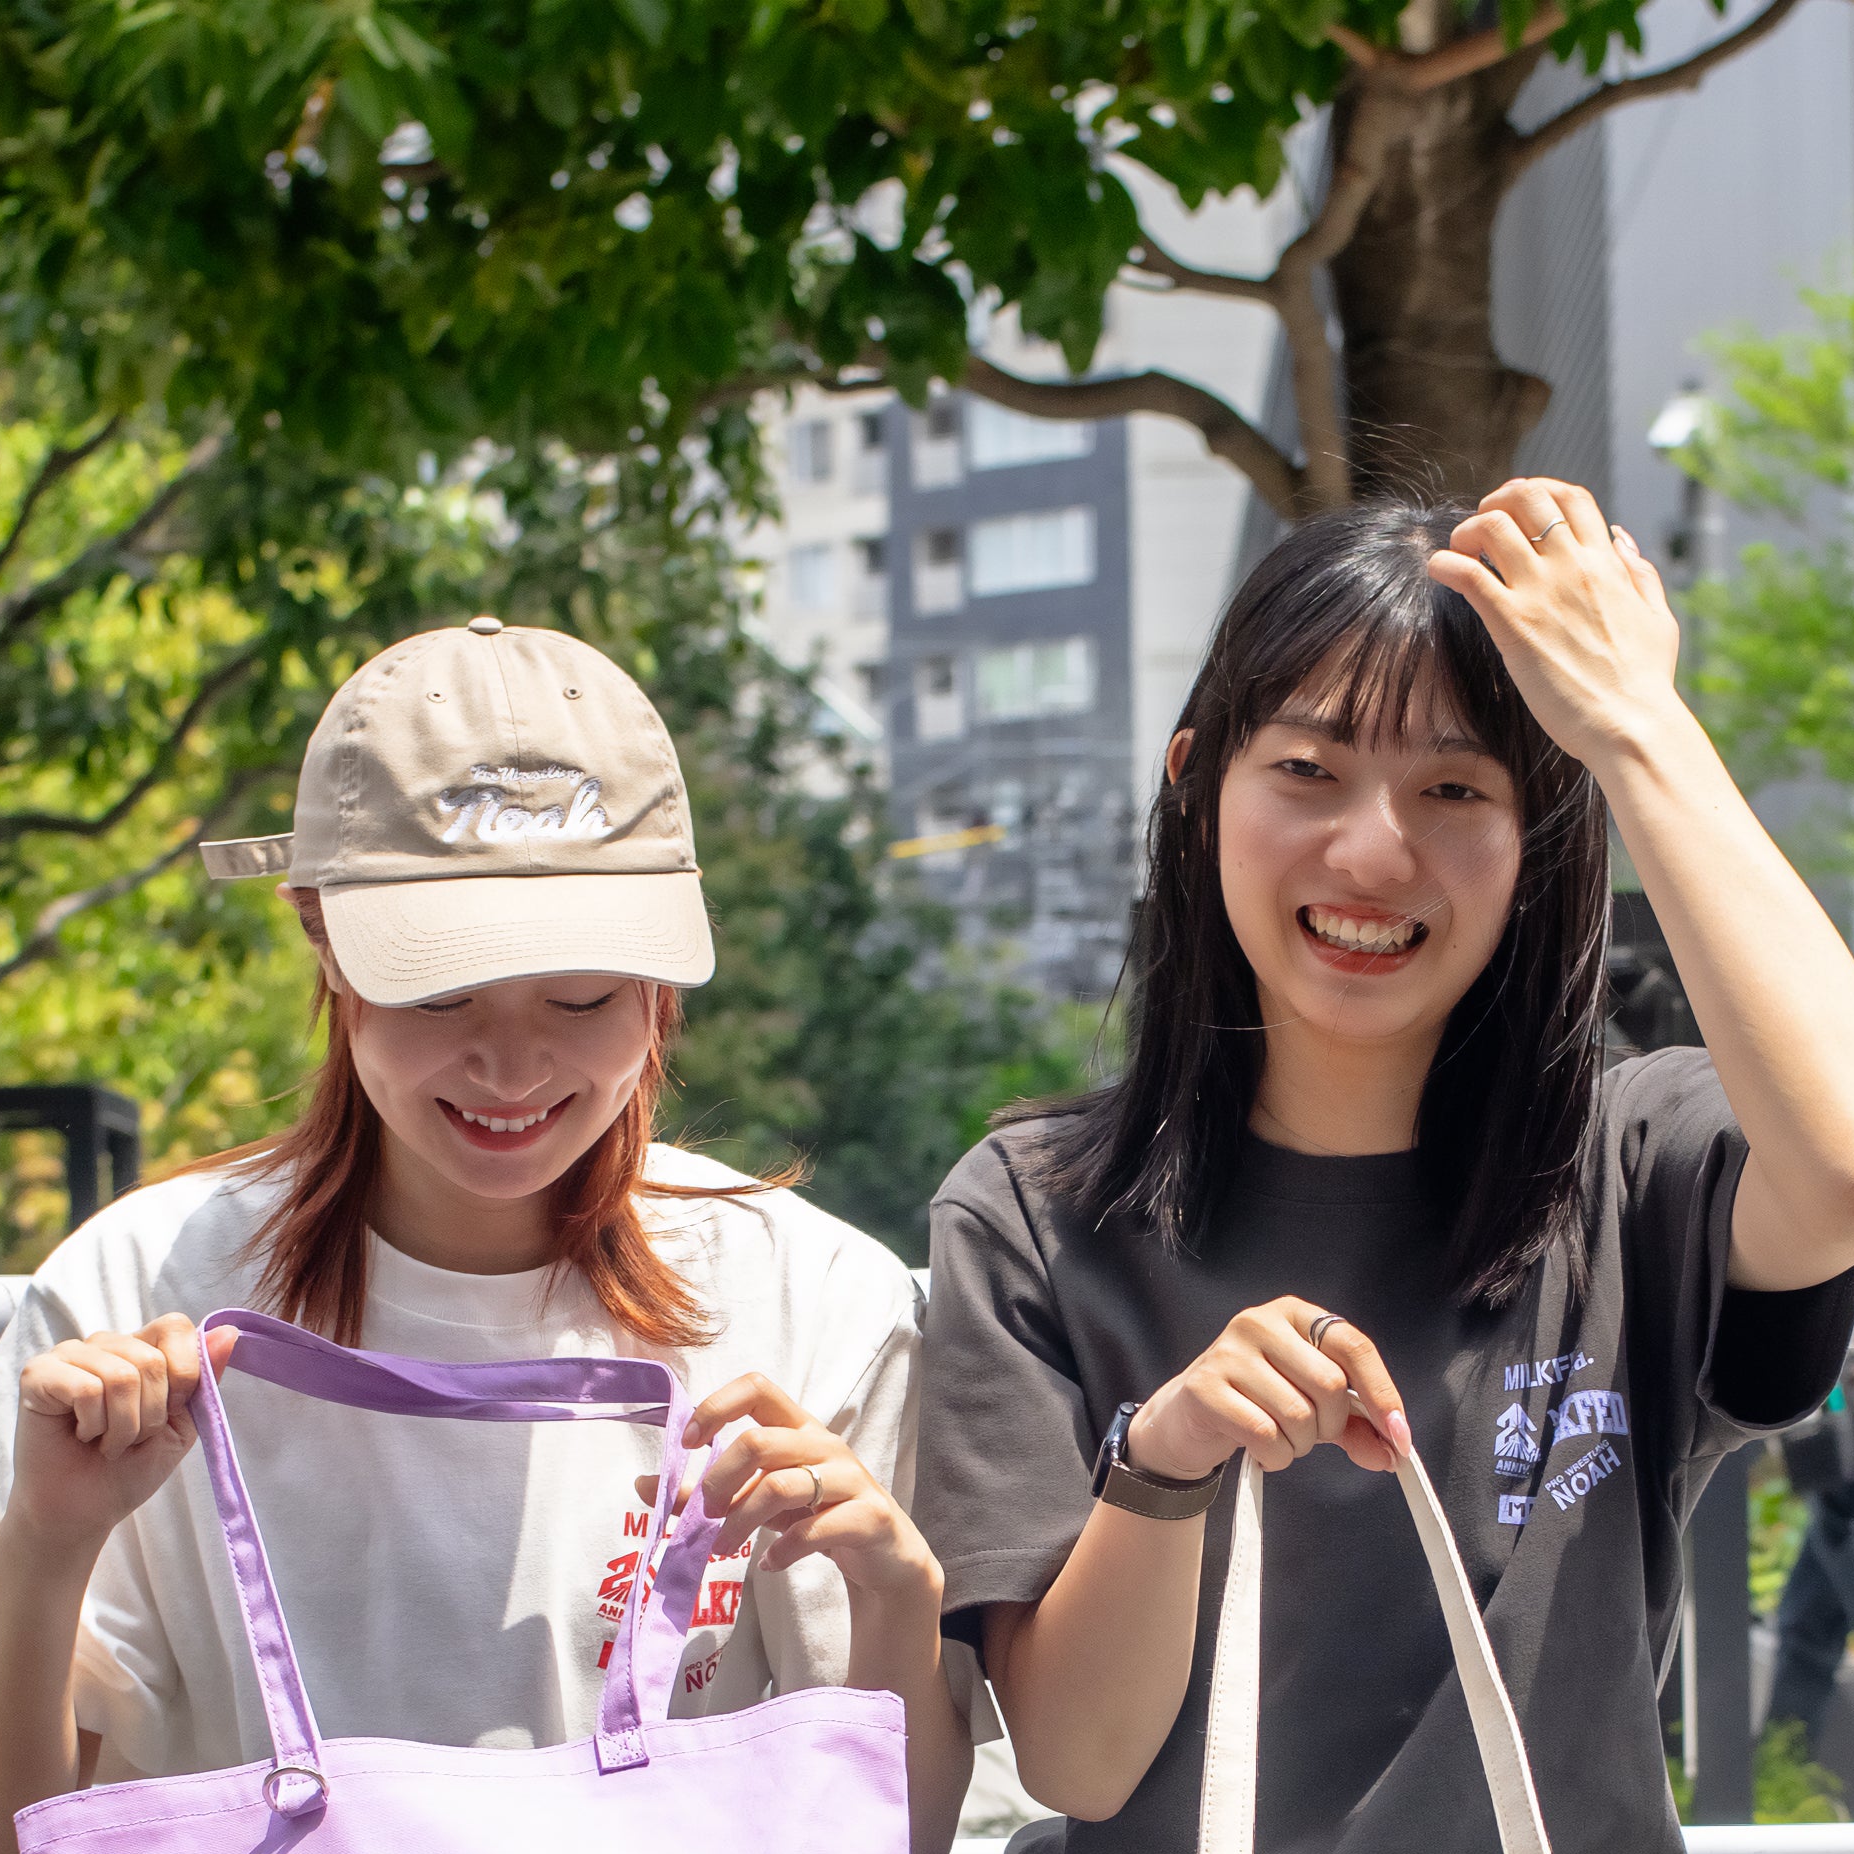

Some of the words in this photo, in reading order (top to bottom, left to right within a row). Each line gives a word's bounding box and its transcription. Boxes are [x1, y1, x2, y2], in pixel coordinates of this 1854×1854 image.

[437, 776, 616, 844] Noah
[1544, 1474, 1565, 1492] PRO
[1564, 1439, 1610, 1477] WRESTLING
[1550, 1445, 1622, 1512] NOAH
